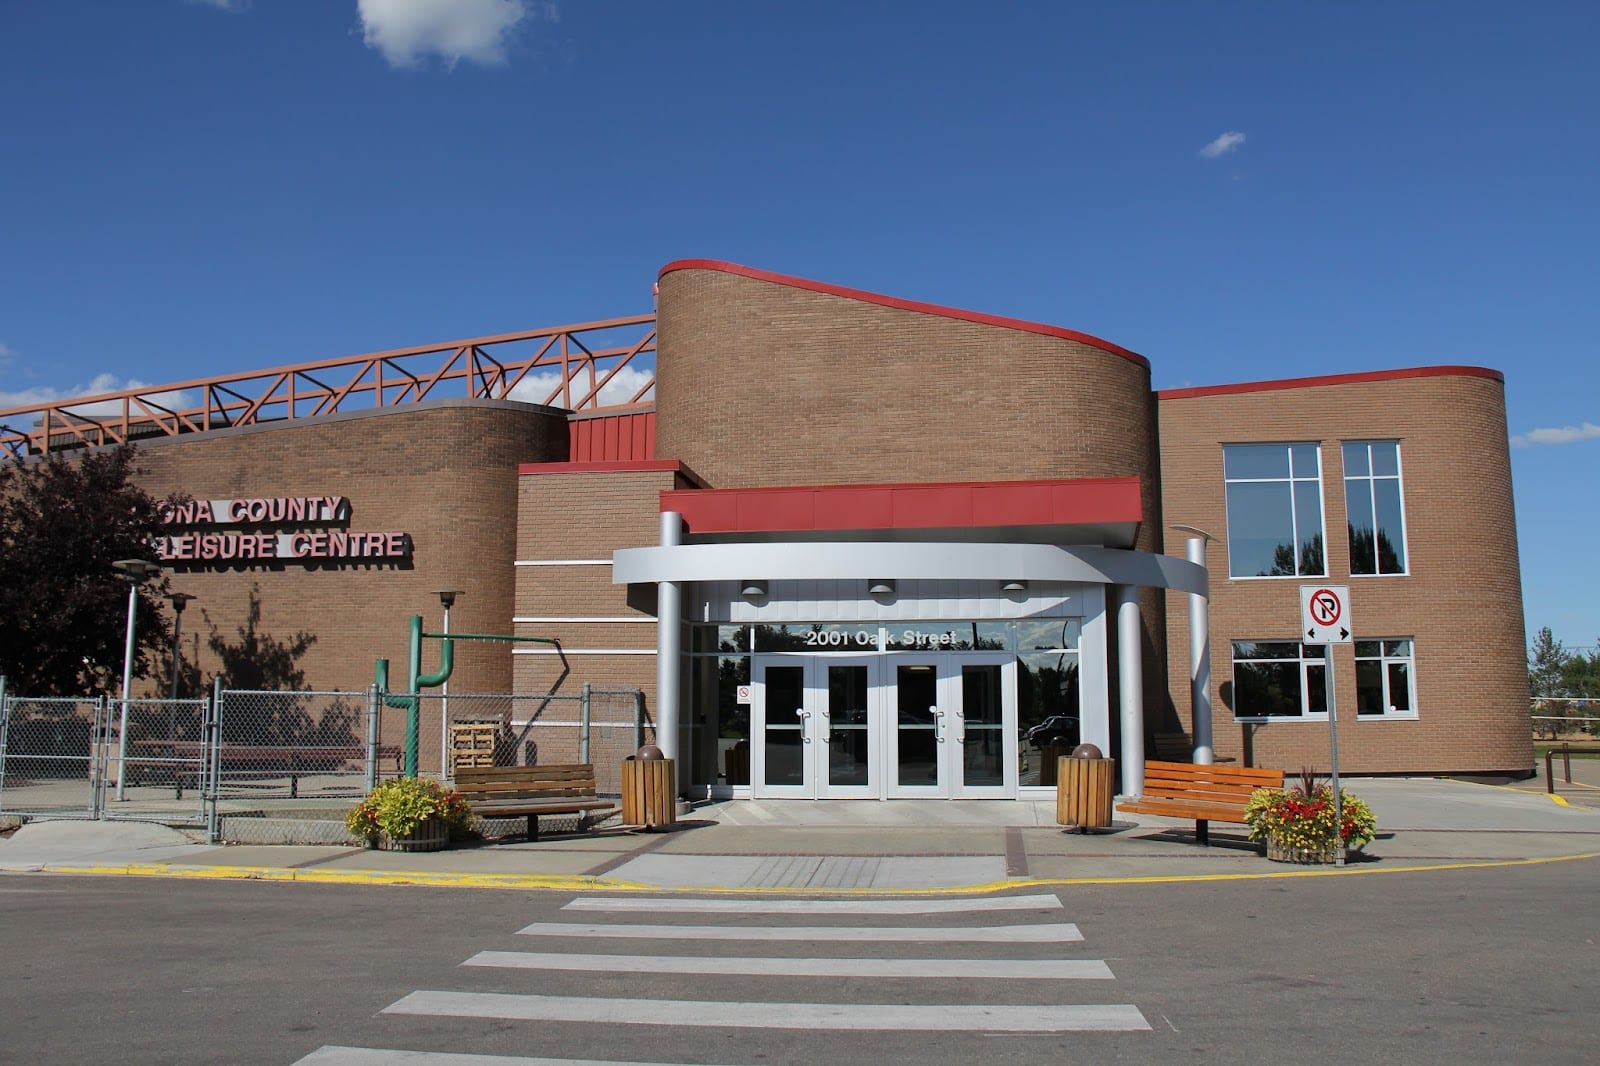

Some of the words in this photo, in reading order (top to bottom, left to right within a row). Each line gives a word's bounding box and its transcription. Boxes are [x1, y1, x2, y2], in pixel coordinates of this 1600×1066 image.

[227, 496, 342, 523] COUNTY
[160, 534, 274, 560] LEISURE
[290, 531, 405, 558] CENTRE
[806, 630, 849, 646] 2001
[855, 630, 896, 646] Oak
[902, 629, 957, 646] Street
